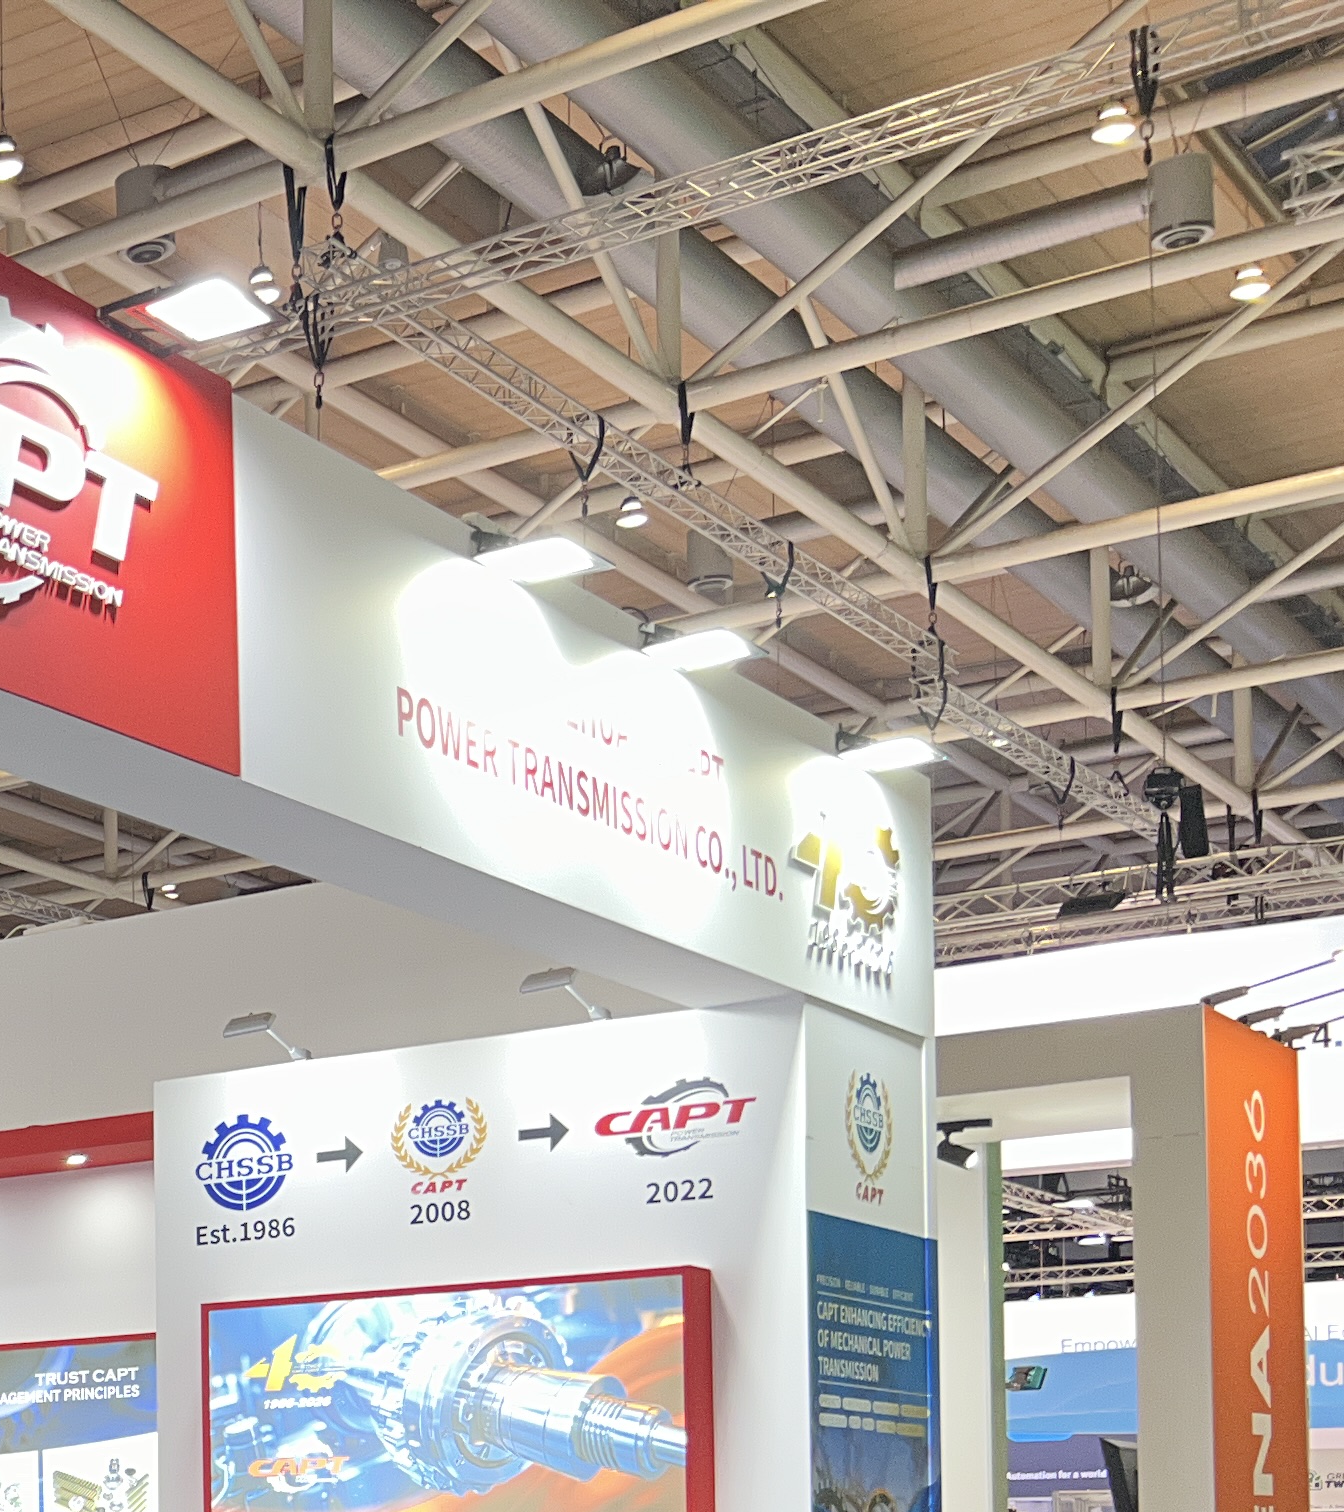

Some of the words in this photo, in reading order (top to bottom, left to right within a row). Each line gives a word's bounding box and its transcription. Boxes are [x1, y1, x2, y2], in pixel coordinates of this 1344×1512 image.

[397, 685, 499, 778] POWER
[508, 738, 688, 860] TRANSMISSION
[696, 825, 738, 892] CO.,
[742, 844, 784, 903] LTD.
[595, 1096, 758, 1137] CAPT
[853, 1104, 884, 1129] CHSSB
[408, 1123, 470, 1141] CHSSB
[195, 1153, 294, 1182] CHSSB
[411, 1178, 468, 1195] CAPT
[646, 1178, 714, 1205] 2022
[855, 1181, 884, 1207] CAPT
[410, 1200, 471, 1225] 2008
[195, 1217, 296, 1246] Est.1986
[816, 1301, 839, 1323] CAPT
[840, 1304, 887, 1331] ENHANCING
[817, 1329, 830, 1348] OF
[830, 1331, 883, 1357] MECHANICAL
[883, 1339, 912, 1361] POWER
[34, 1369, 90, 1388] TRUST
[92, 1366, 139, 1383] CAPT
[817, 1356, 879, 1382] TRANSMISSION
[63, 1384, 141, 1401] PRINCIPLES
[247, 1456, 351, 1478] CAPT
[1058, 1469, 1072, 1479] for
[1081, 1469, 1108, 1479] world
